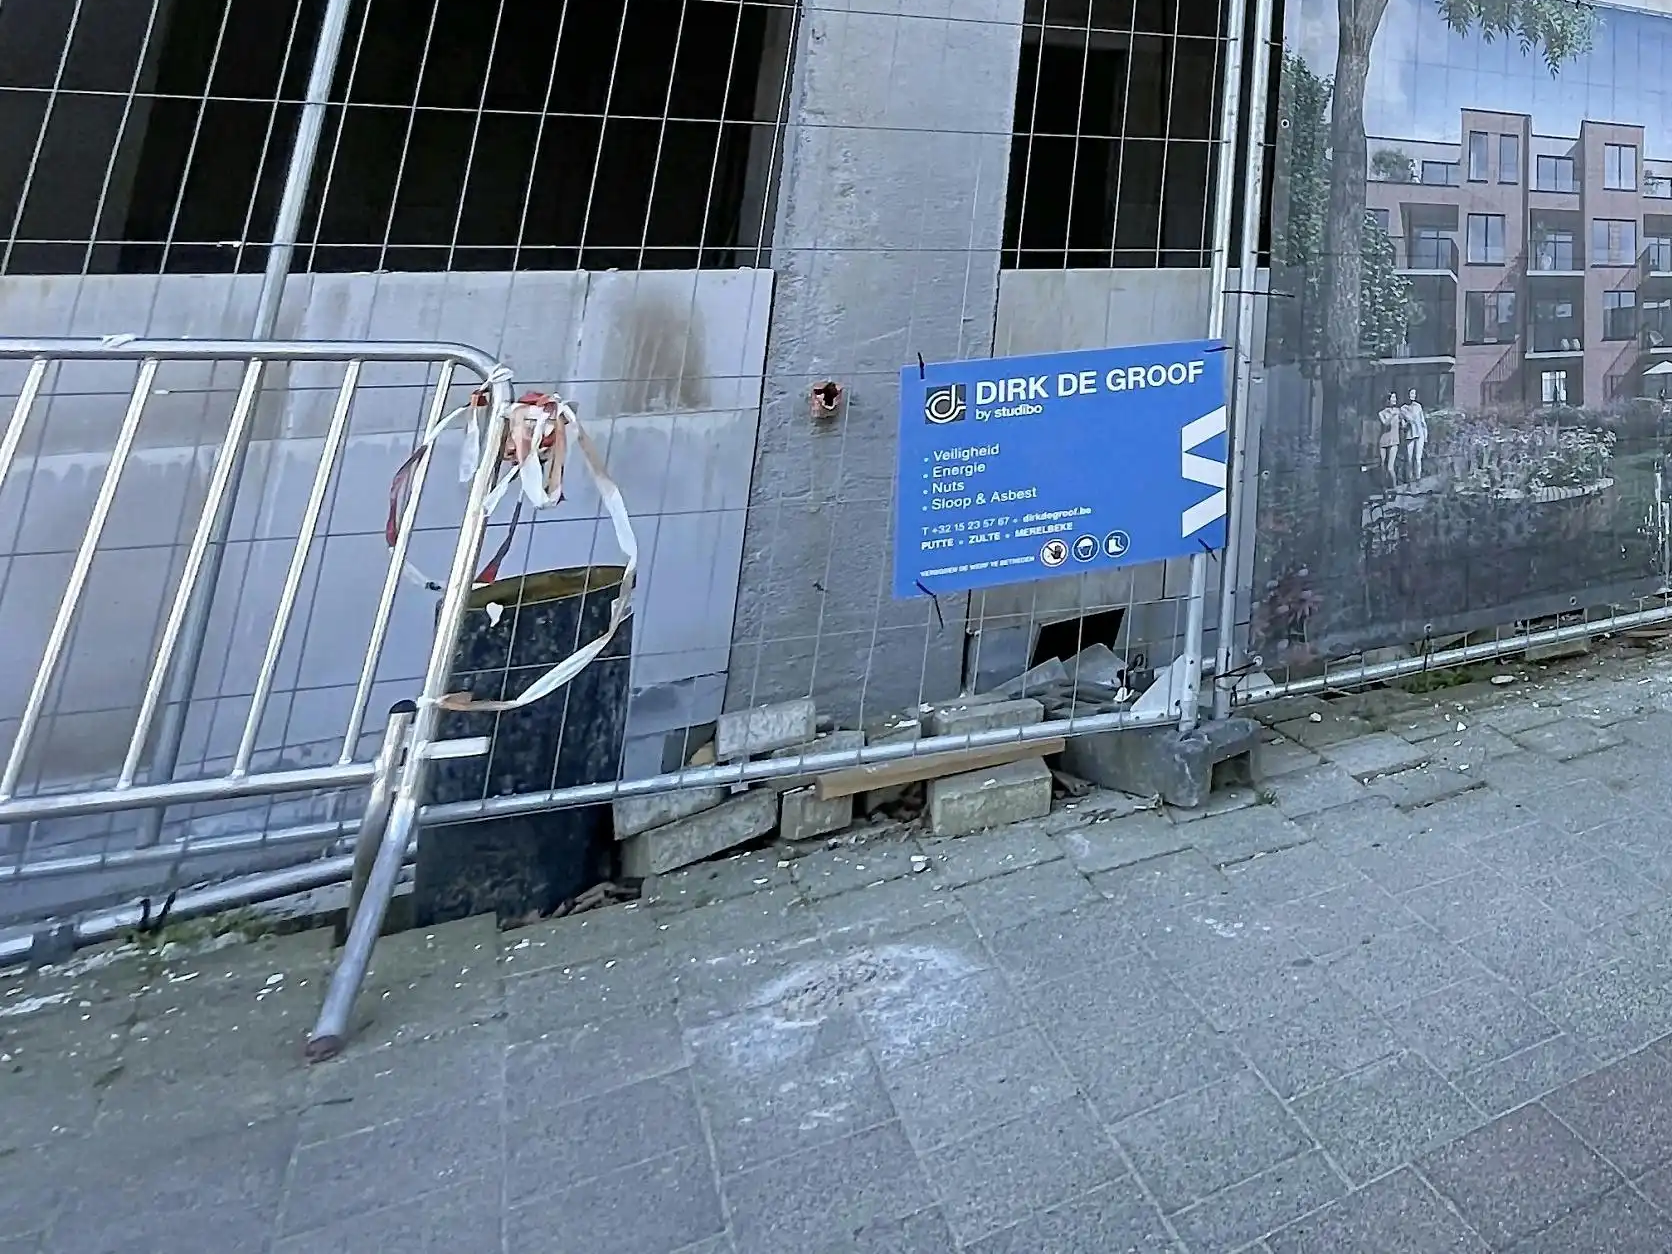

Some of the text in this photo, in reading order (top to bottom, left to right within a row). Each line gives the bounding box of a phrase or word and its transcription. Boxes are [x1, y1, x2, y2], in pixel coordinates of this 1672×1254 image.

[976, 361, 1205, 405] DIRK DE GROOF
[975, 403, 1043, 422] by studibo
[933, 443, 1000, 461] Veiligheid
[932, 462, 986, 478] Energie
[931, 486, 1038, 511] Sloop & Asbest
[932, 481, 965, 495] Nuts
[921, 526, 929, 536] T
[931, 524, 951, 534] +32
[954, 523, 965, 533] 15
[967, 521, 980, 530] 23
[1022, 507, 1092, 523] dirkdegroof.be
[921, 522, 1073, 550] PUTTE ZULTE MERELBEKE
